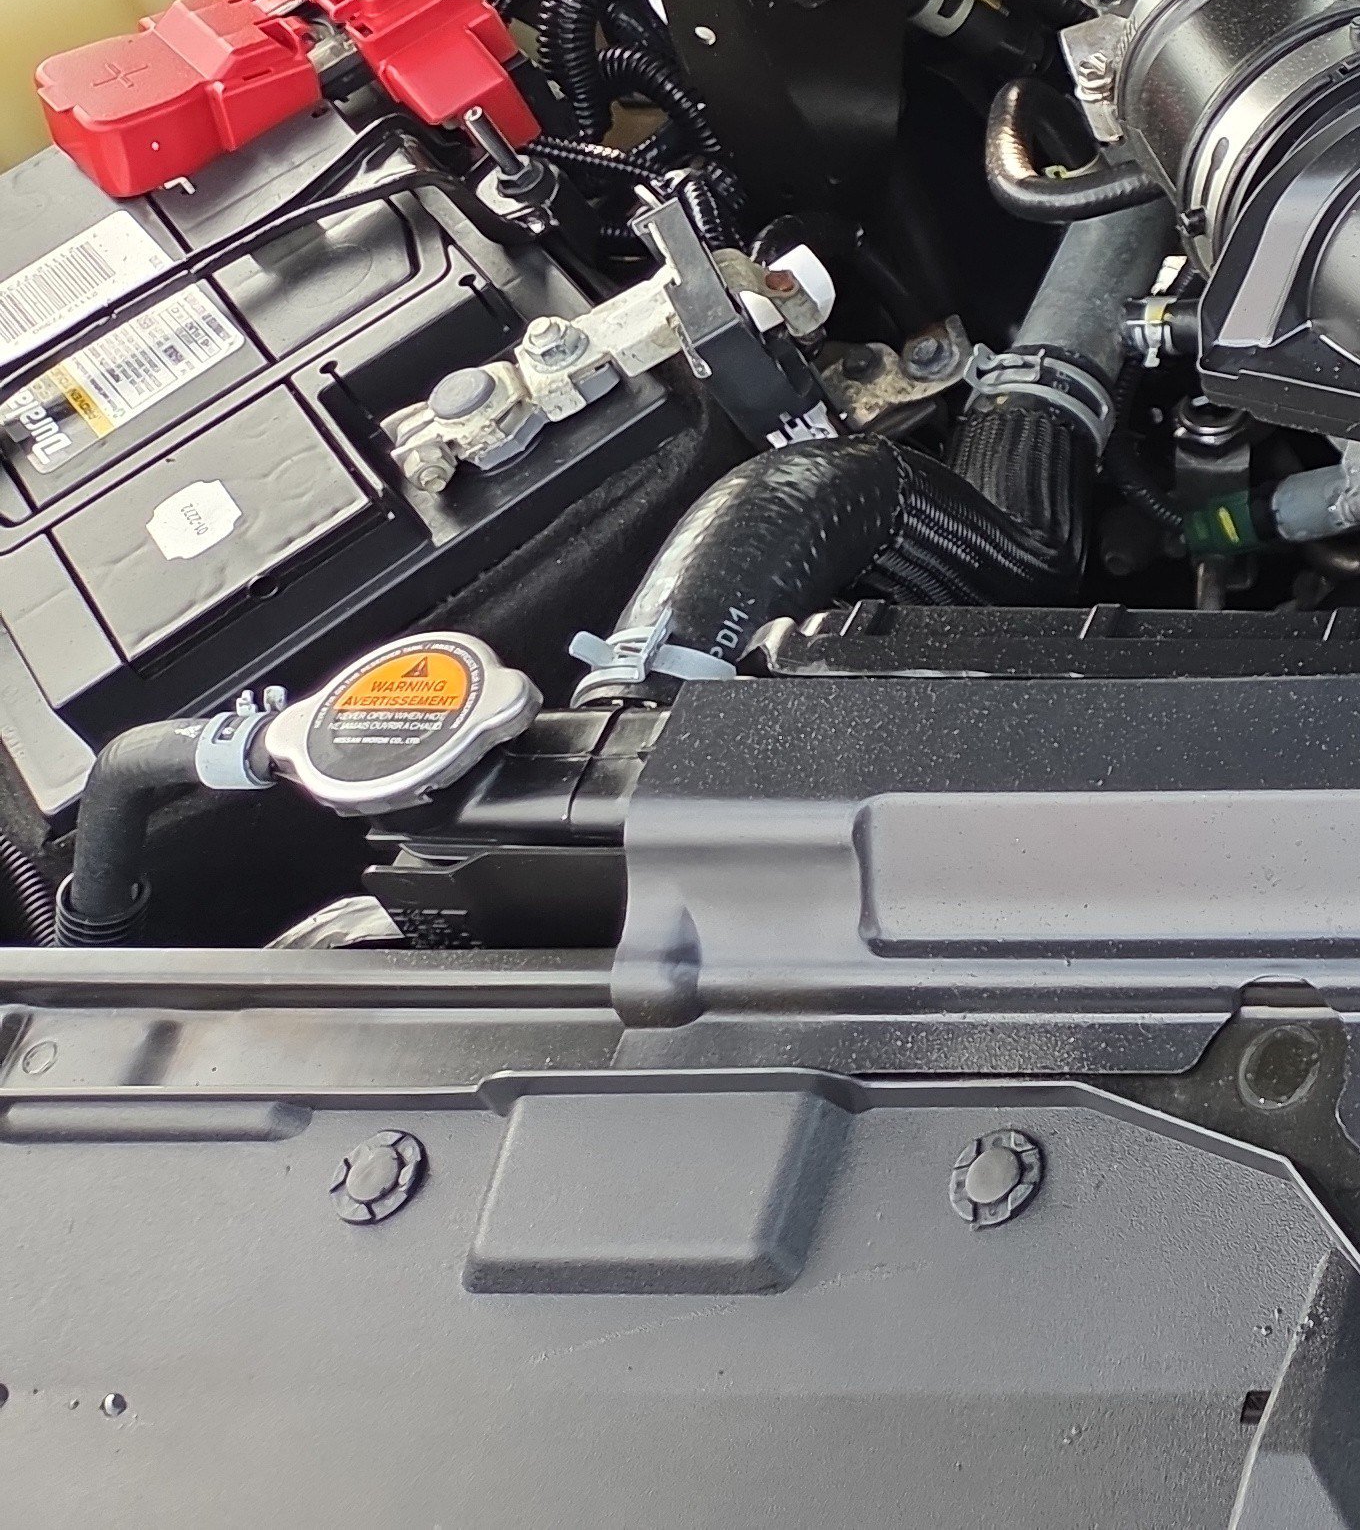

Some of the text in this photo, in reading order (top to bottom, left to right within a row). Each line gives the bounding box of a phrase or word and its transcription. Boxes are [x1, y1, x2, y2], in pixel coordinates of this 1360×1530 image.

[3, 390, 73, 465] Durala
[371, 680, 447, 692] WARNING
[342, 696, 458, 706] AVERTISSEMENT
